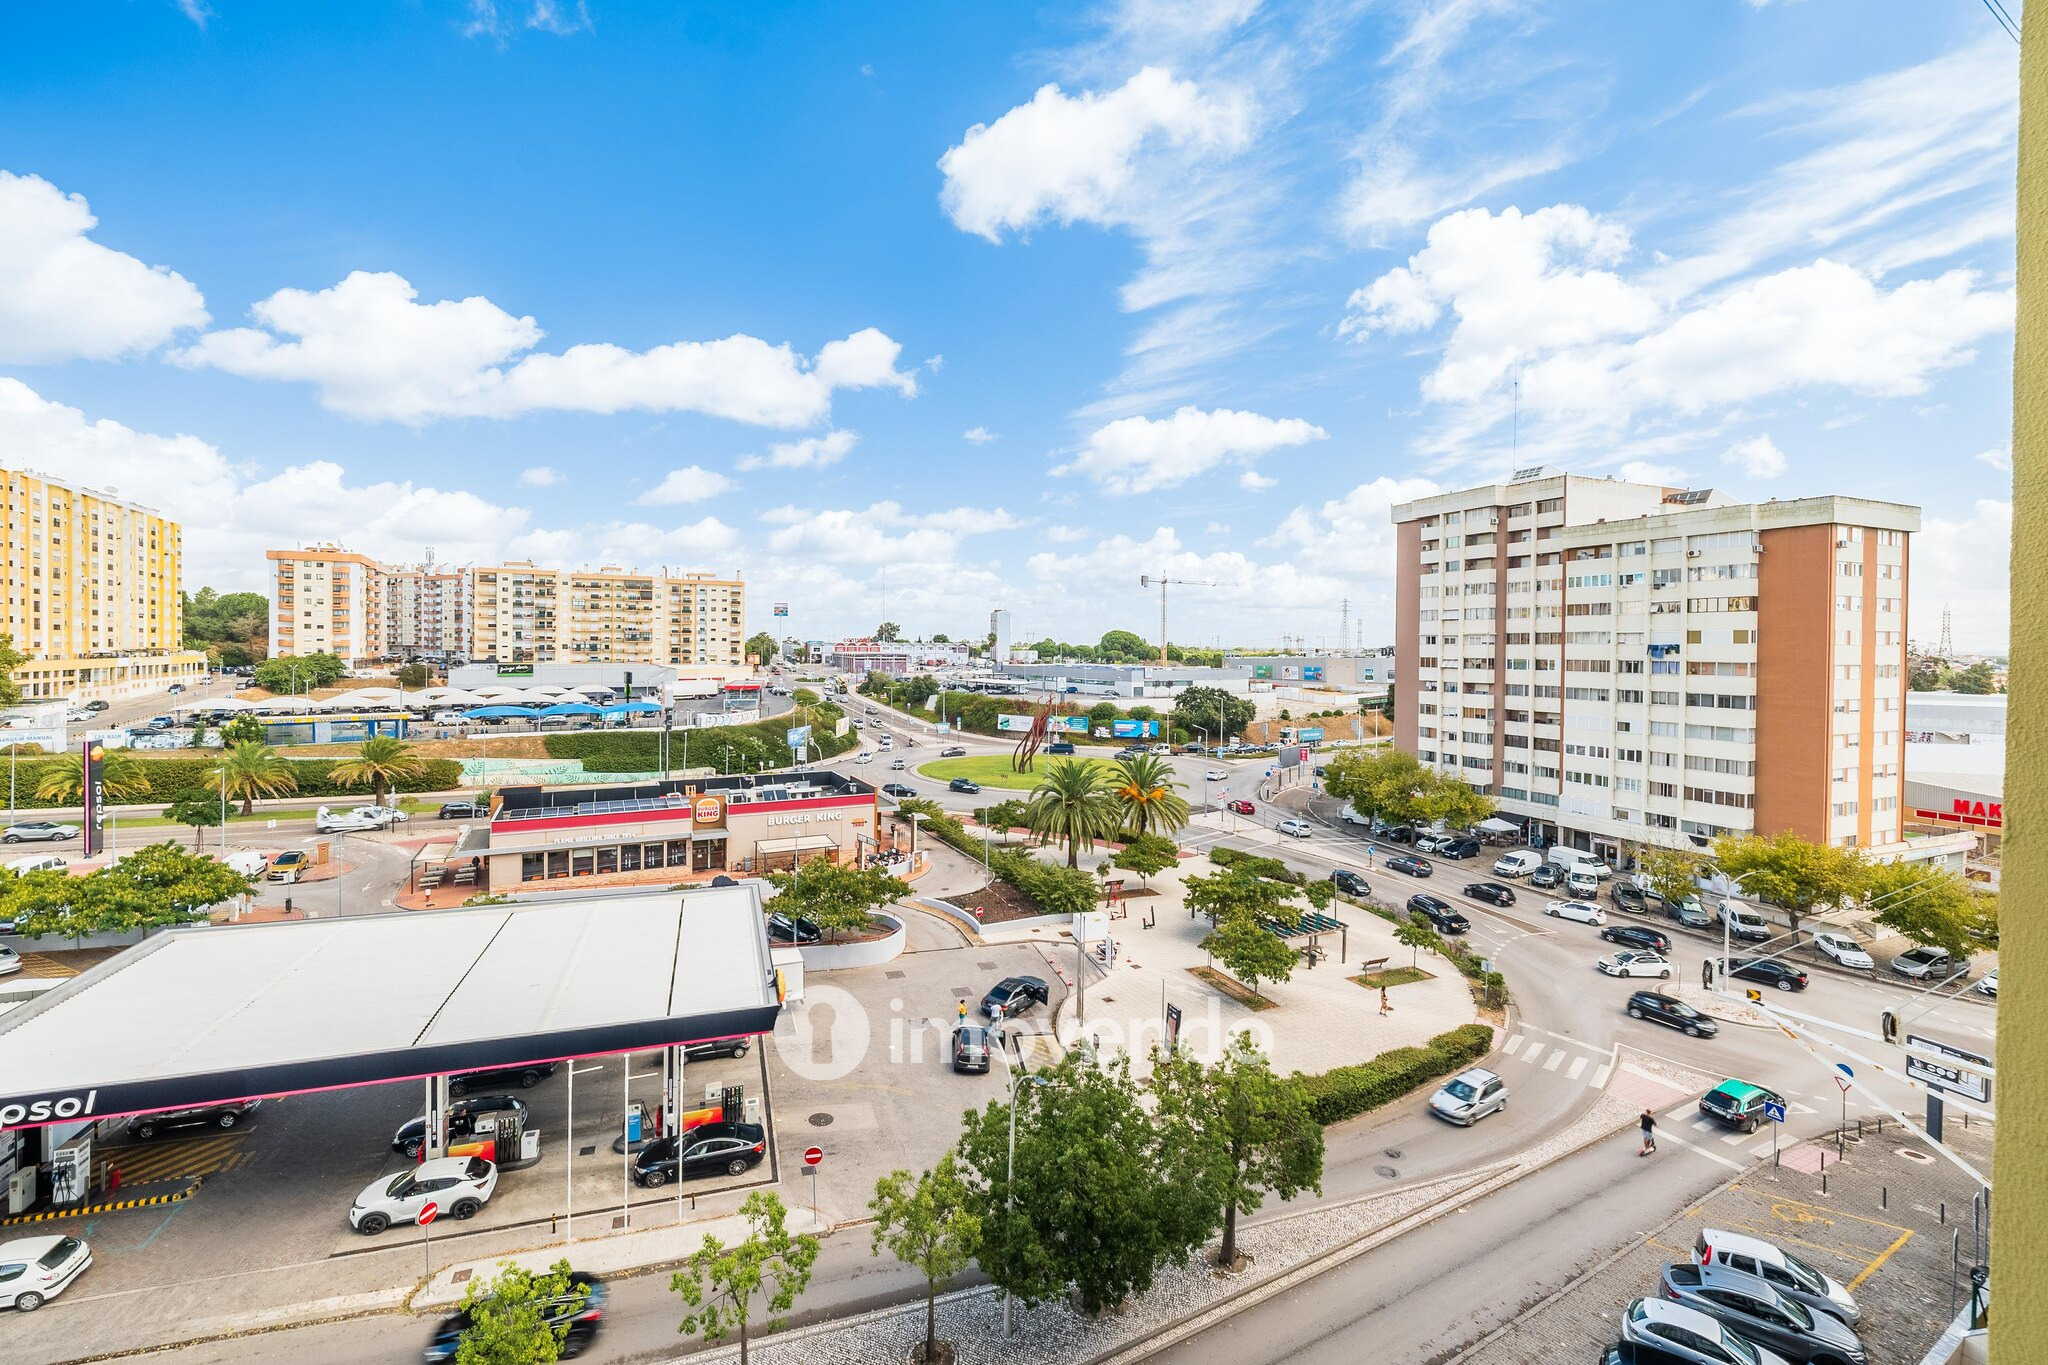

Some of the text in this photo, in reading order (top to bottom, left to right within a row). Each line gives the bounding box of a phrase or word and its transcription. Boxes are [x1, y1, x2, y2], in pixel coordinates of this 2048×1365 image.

[95, 781, 104, 830] repsol
[768, 812, 843, 826] BURGER KING
